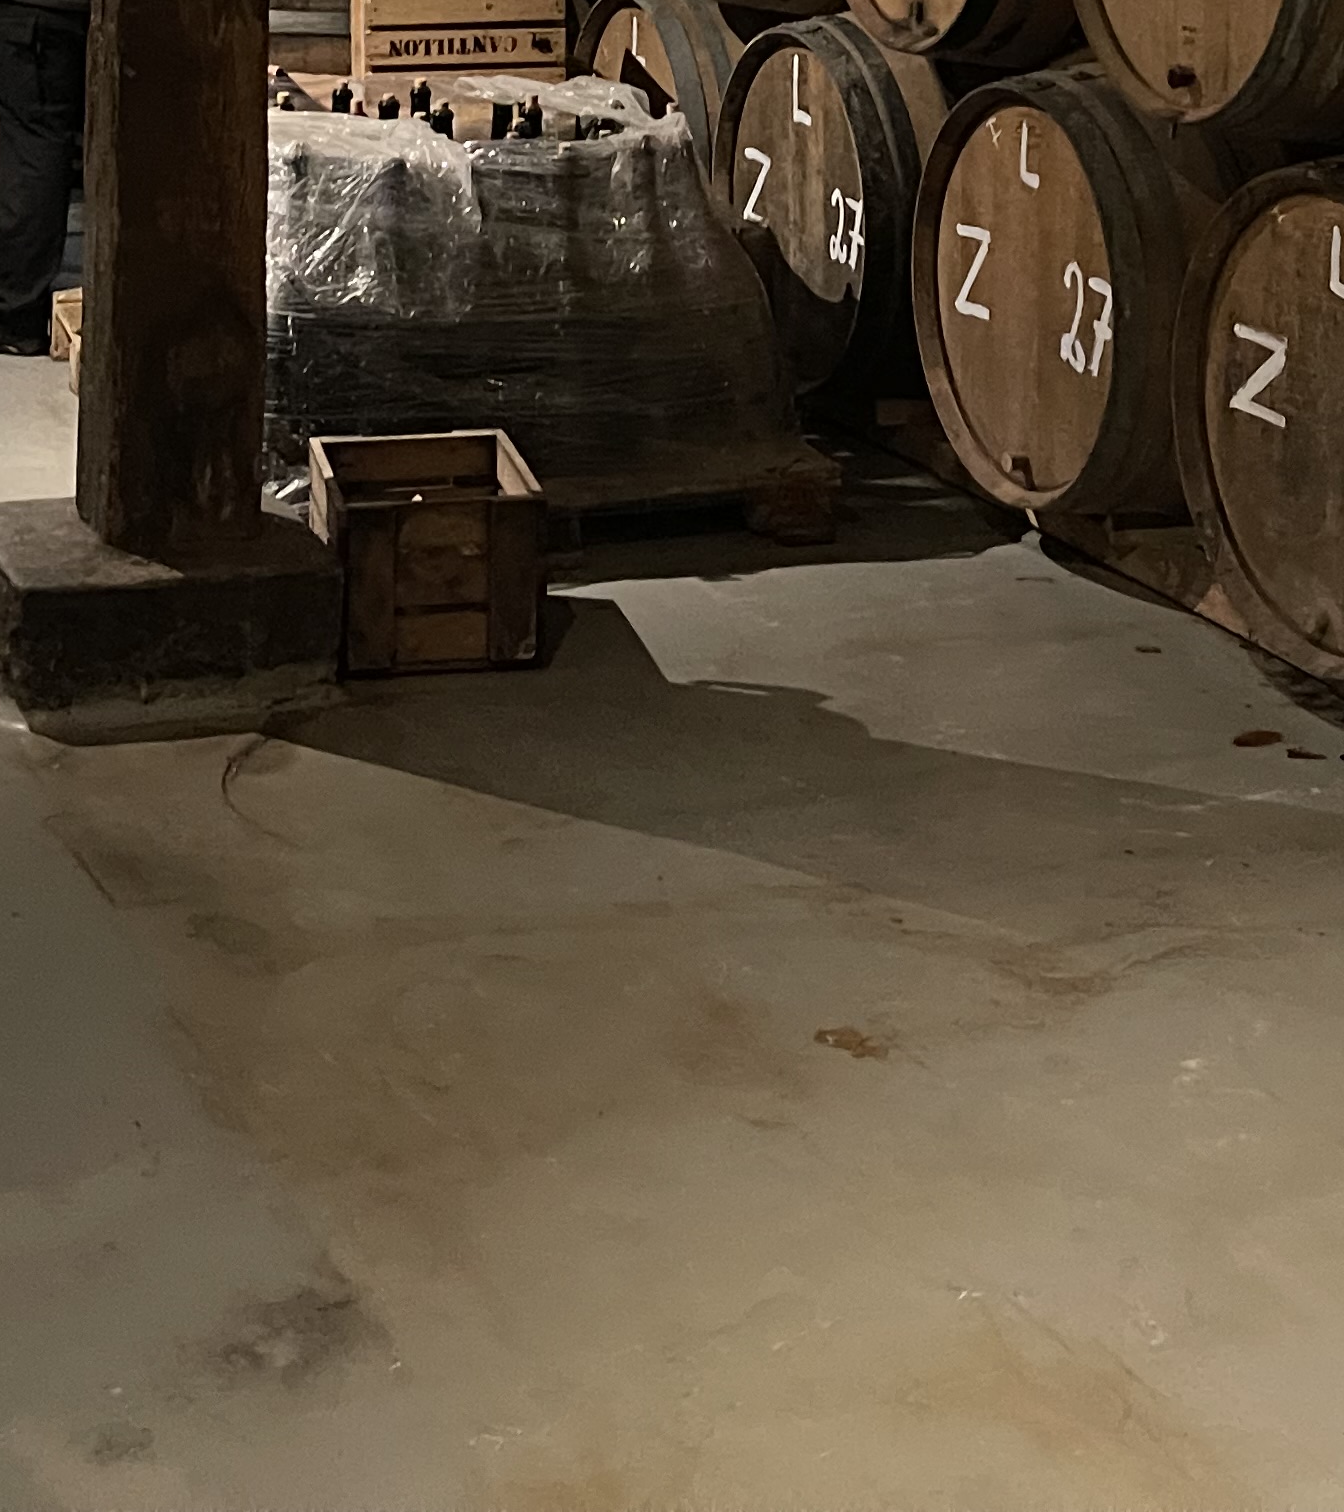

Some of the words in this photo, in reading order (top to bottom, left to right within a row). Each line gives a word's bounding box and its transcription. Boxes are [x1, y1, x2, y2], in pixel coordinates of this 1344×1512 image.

[388, 34, 518, 58] CANTILLON
[793, 54, 812, 126] L
[1020, 120, 1040, 190] L
[744, 148, 771, 223] Z
[830, 188, 864, 270] 27
[955, 223, 990, 321] Z
[1060, 261, 1114, 377] 27
[1229, 323, 1288, 428] Z
